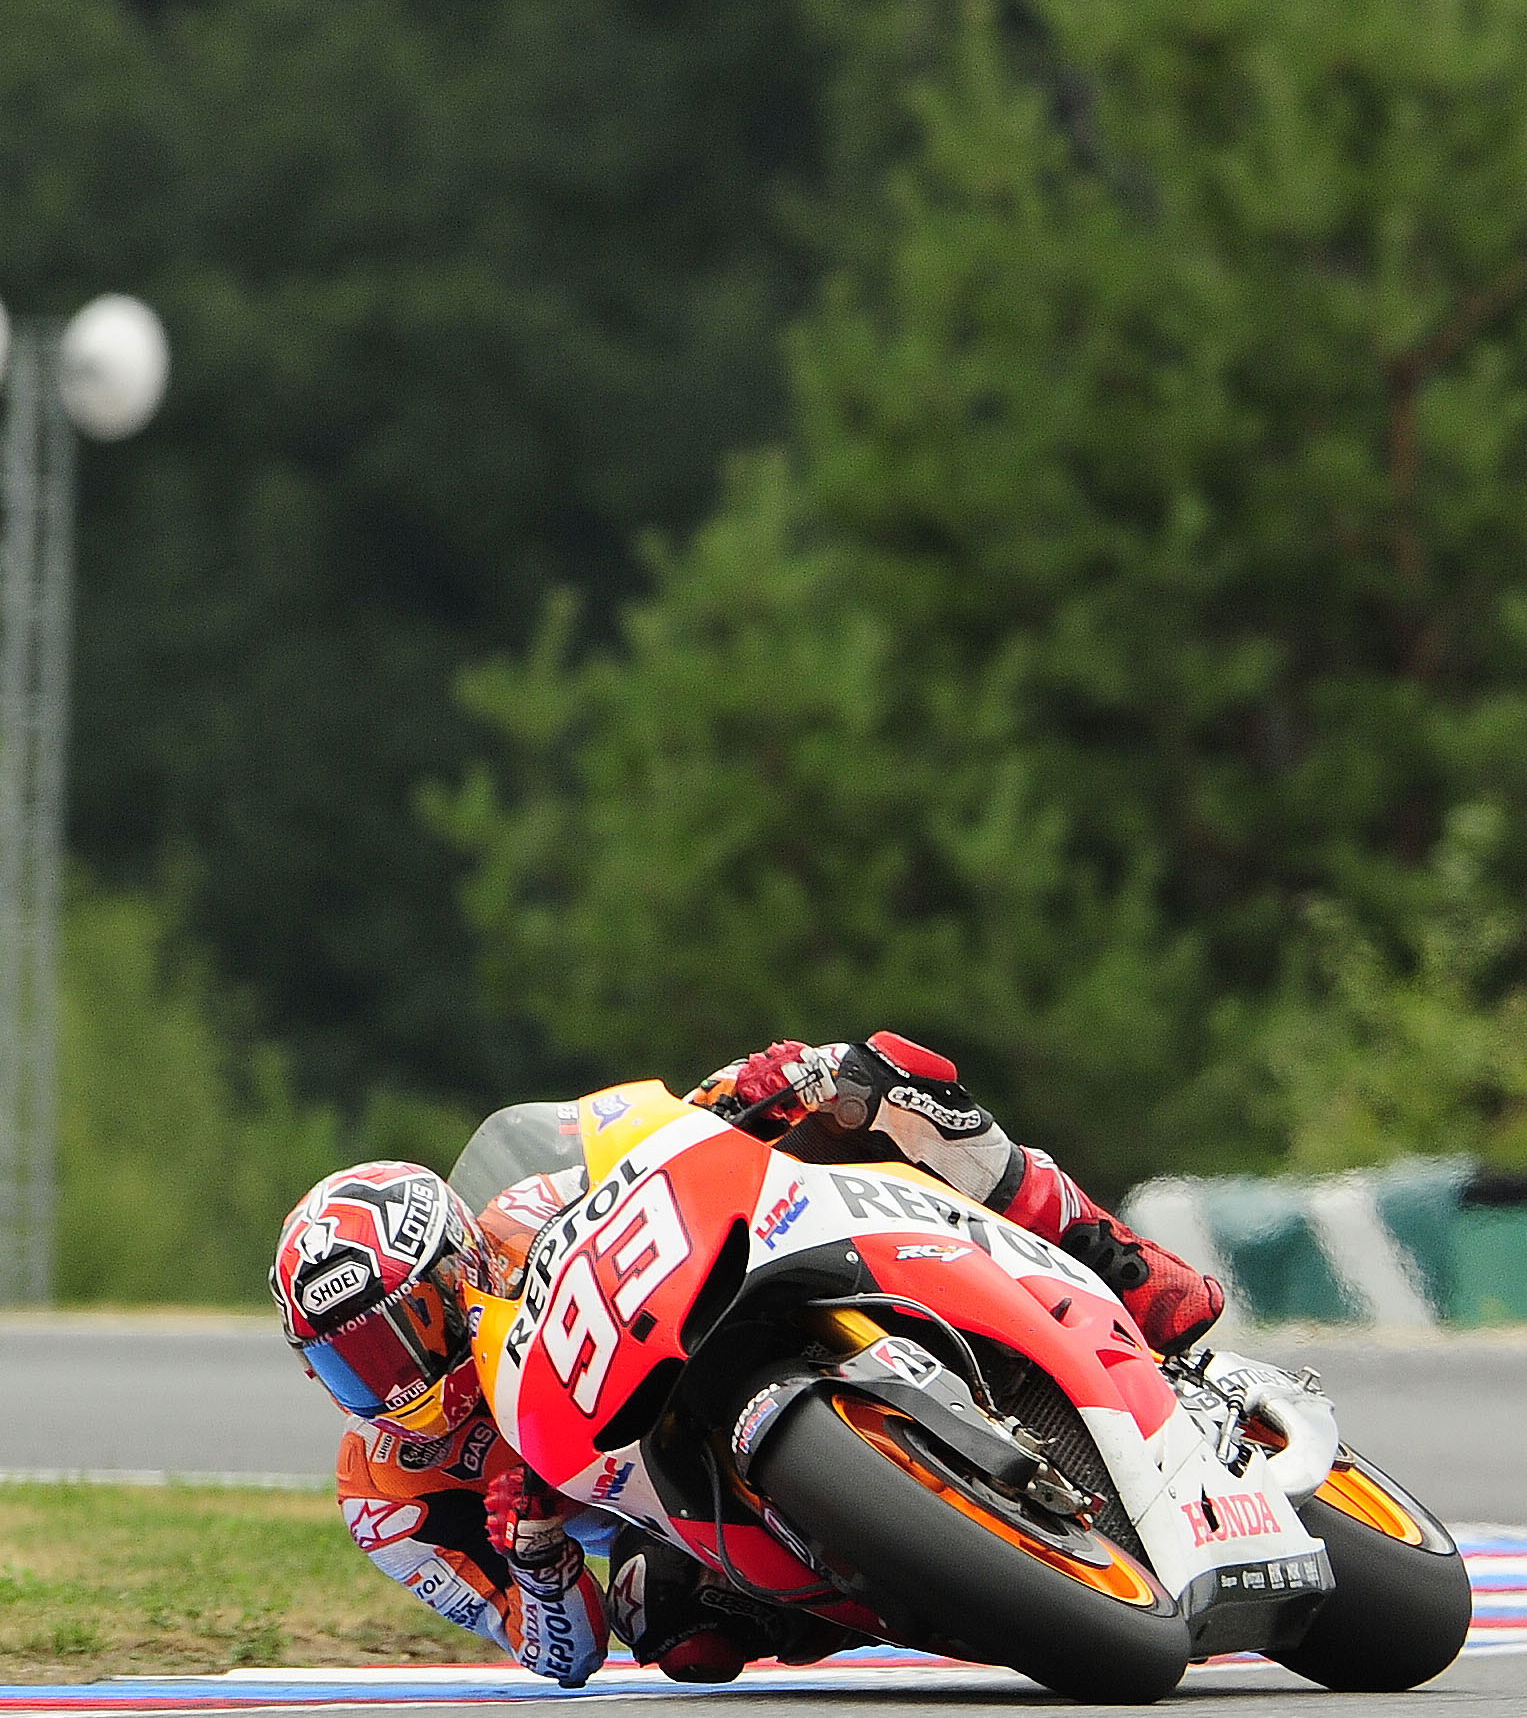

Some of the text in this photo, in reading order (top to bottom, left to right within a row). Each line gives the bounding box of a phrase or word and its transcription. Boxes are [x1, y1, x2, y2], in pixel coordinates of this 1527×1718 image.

[394, 1181, 434, 1256] LOTUS
[829, 1173, 1087, 1284] REPSOL
[310, 1269, 361, 1307] SHOEI
[505, 1158, 649, 1370] REPSOL
[540, 1169, 694, 1419] 93
[336, 1313, 368, 1336] YOU
[384, 1381, 428, 1411] LOTUS
[463, 1426, 493, 1471] GAS
[1181, 1492, 1281, 1548] HONDA
[520, 1603, 542, 1669] HONDA
